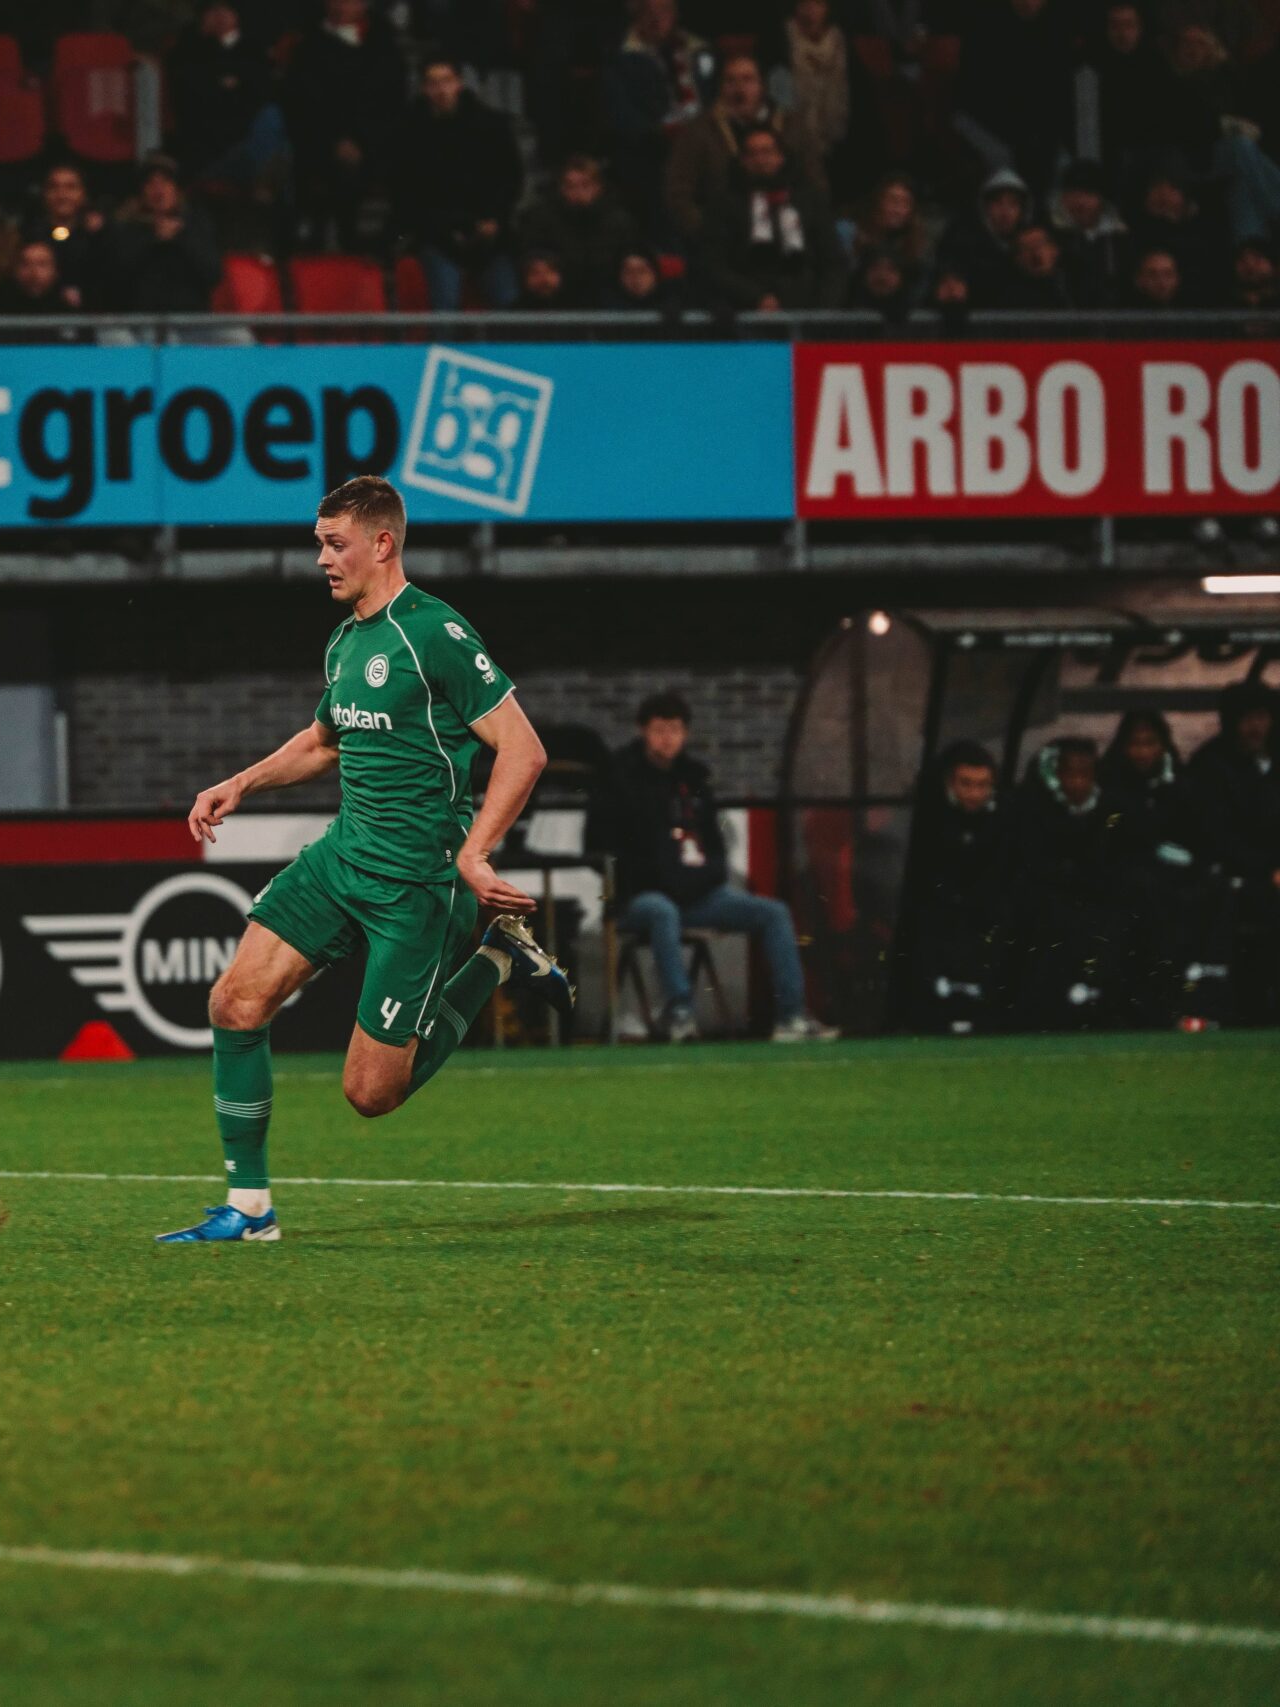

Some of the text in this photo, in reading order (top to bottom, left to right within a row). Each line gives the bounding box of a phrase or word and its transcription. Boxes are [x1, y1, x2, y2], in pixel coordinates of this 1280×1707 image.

[807, 358, 1280, 498] ARBO RO
[330, 702, 393, 731] utokan
[141, 936, 238, 985] MIN
[380, 996, 402, 1030] 4
